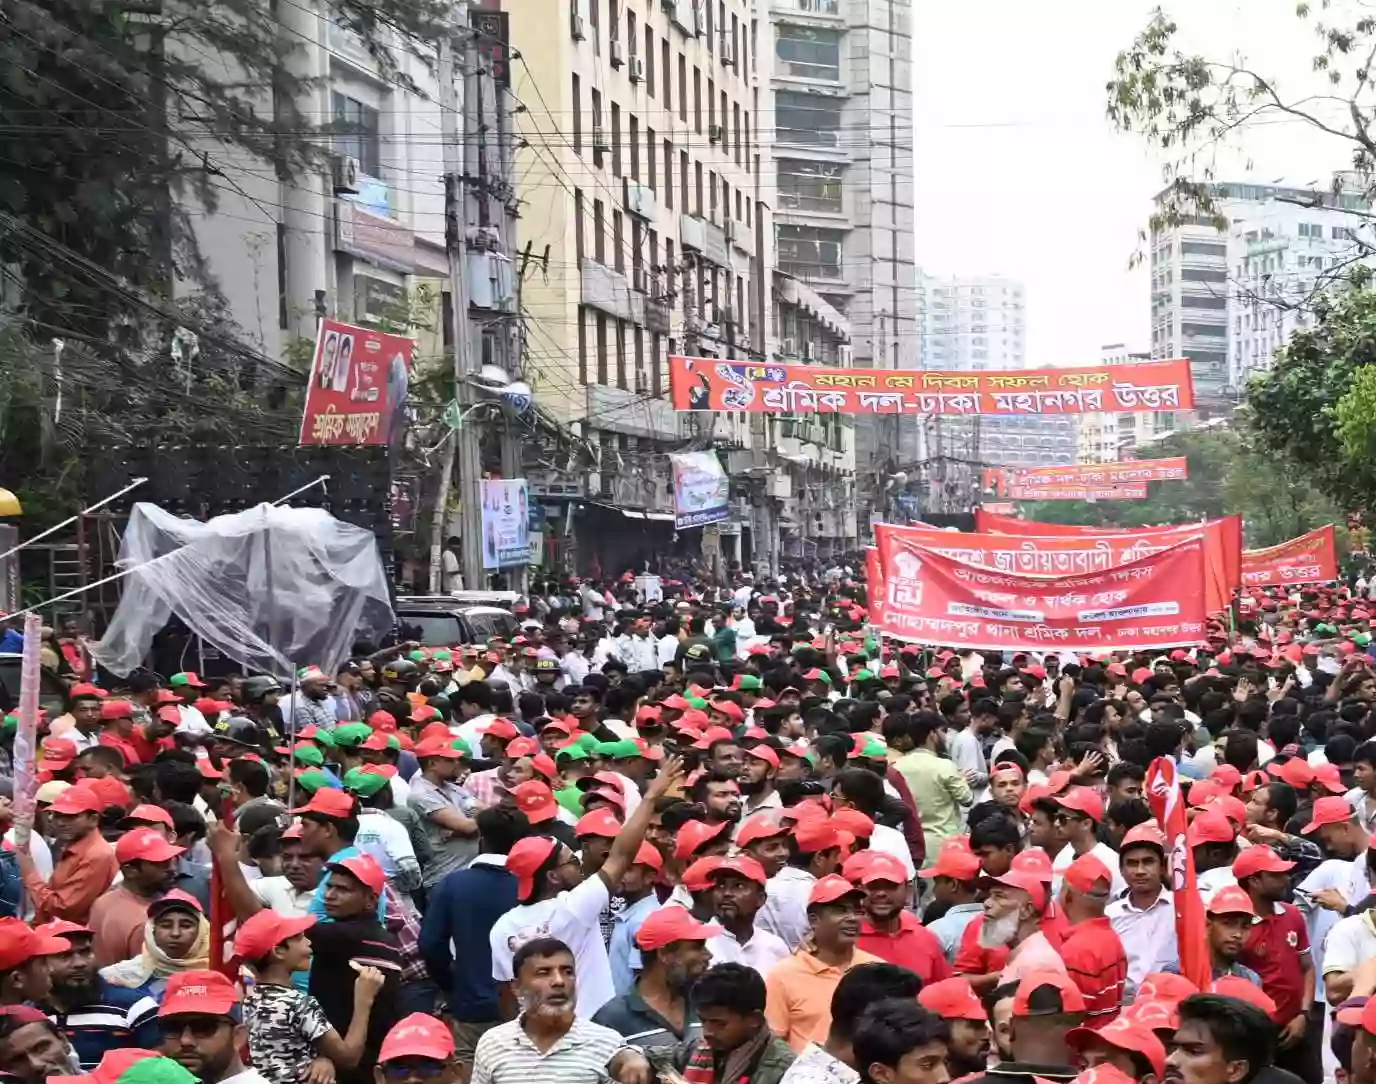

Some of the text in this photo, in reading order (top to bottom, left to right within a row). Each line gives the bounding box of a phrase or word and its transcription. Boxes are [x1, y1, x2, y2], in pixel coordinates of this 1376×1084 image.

[813, 372, 1109, 389] মহান মে দিবস সফল হোক
[762, 380, 847, 412] শ্রমিক
[990, 389, 1103, 413] মহানগর
[1112, 381, 1180, 409] উত্তর
[993, 540, 1113, 574] জাতীয়তাবাদী
[985, 622, 1020, 640] থানা
[1023, 622, 1069, 641] শ্রমিক
